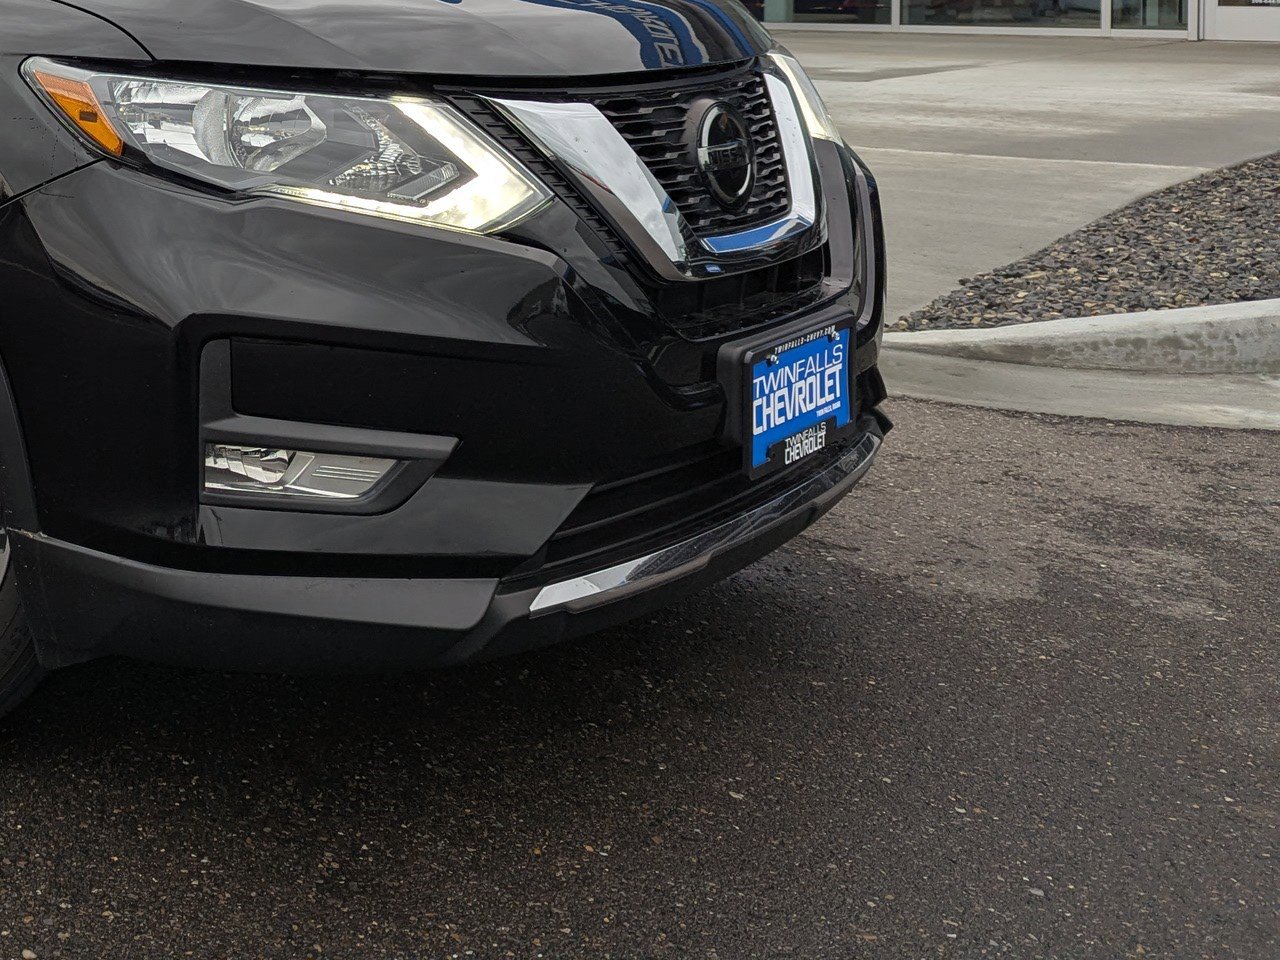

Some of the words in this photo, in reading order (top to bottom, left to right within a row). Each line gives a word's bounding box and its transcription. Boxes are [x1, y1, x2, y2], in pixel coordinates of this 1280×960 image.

[753, 344, 843, 398] TWINFALLS
[752, 363, 843, 436] CHEVROLET
[784, 431, 827, 465] CHEVROLET
